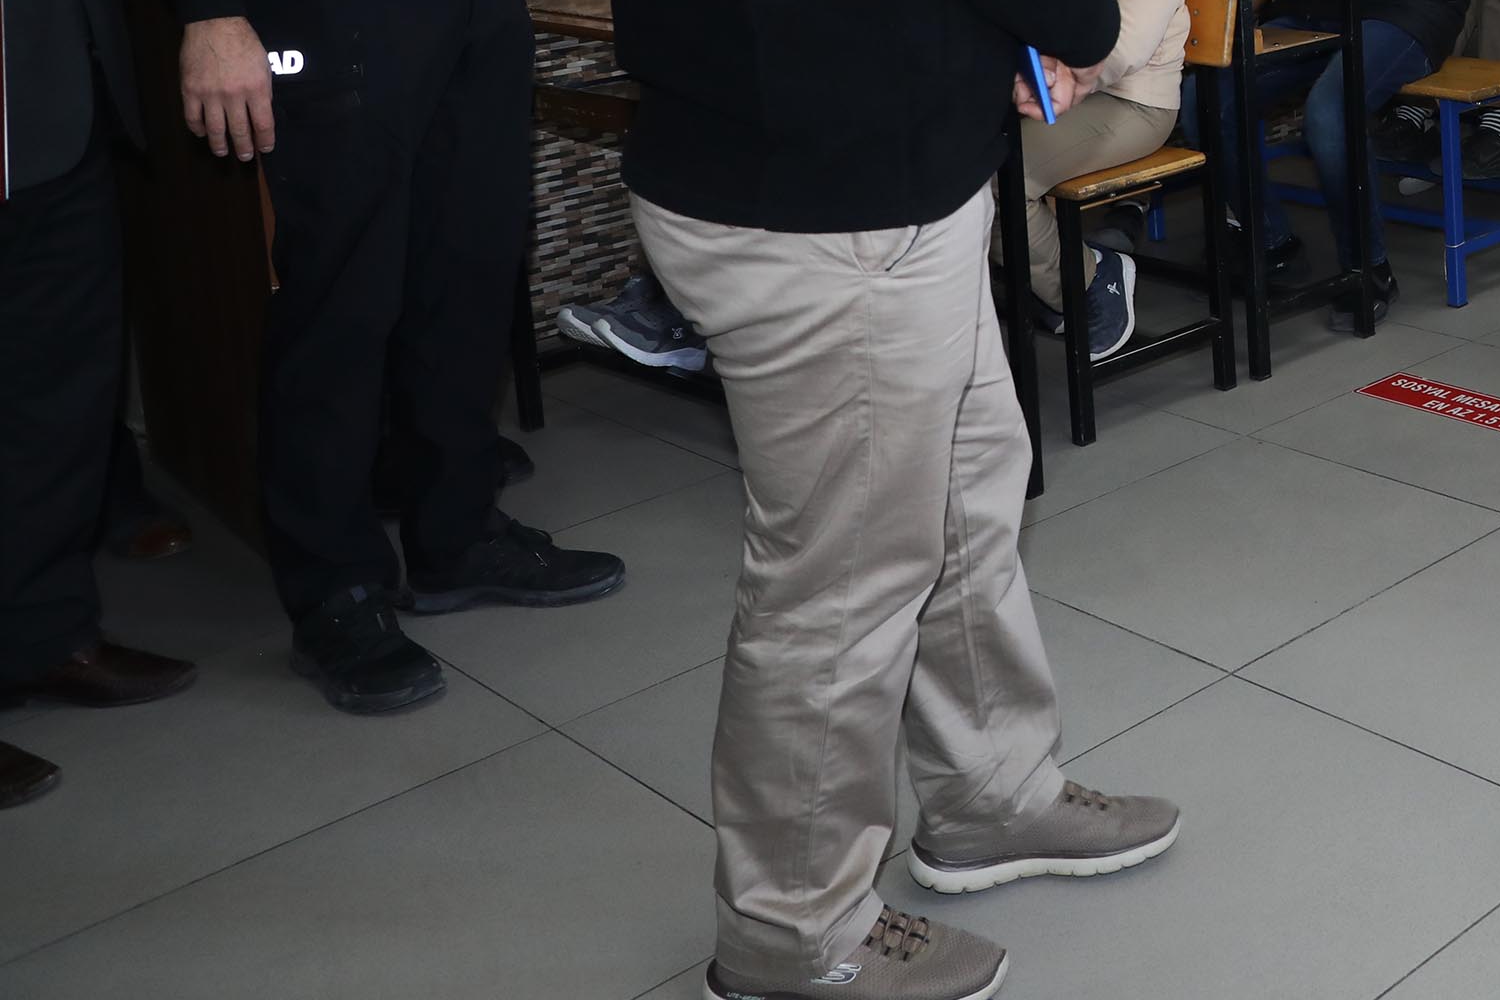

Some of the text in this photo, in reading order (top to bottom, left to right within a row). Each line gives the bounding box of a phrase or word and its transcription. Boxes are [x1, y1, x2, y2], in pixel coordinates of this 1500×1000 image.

[1391, 379, 1452, 399] SOSYAL
[1422, 400, 1451, 411] EN
[1446, 407, 1475, 418] AZ
